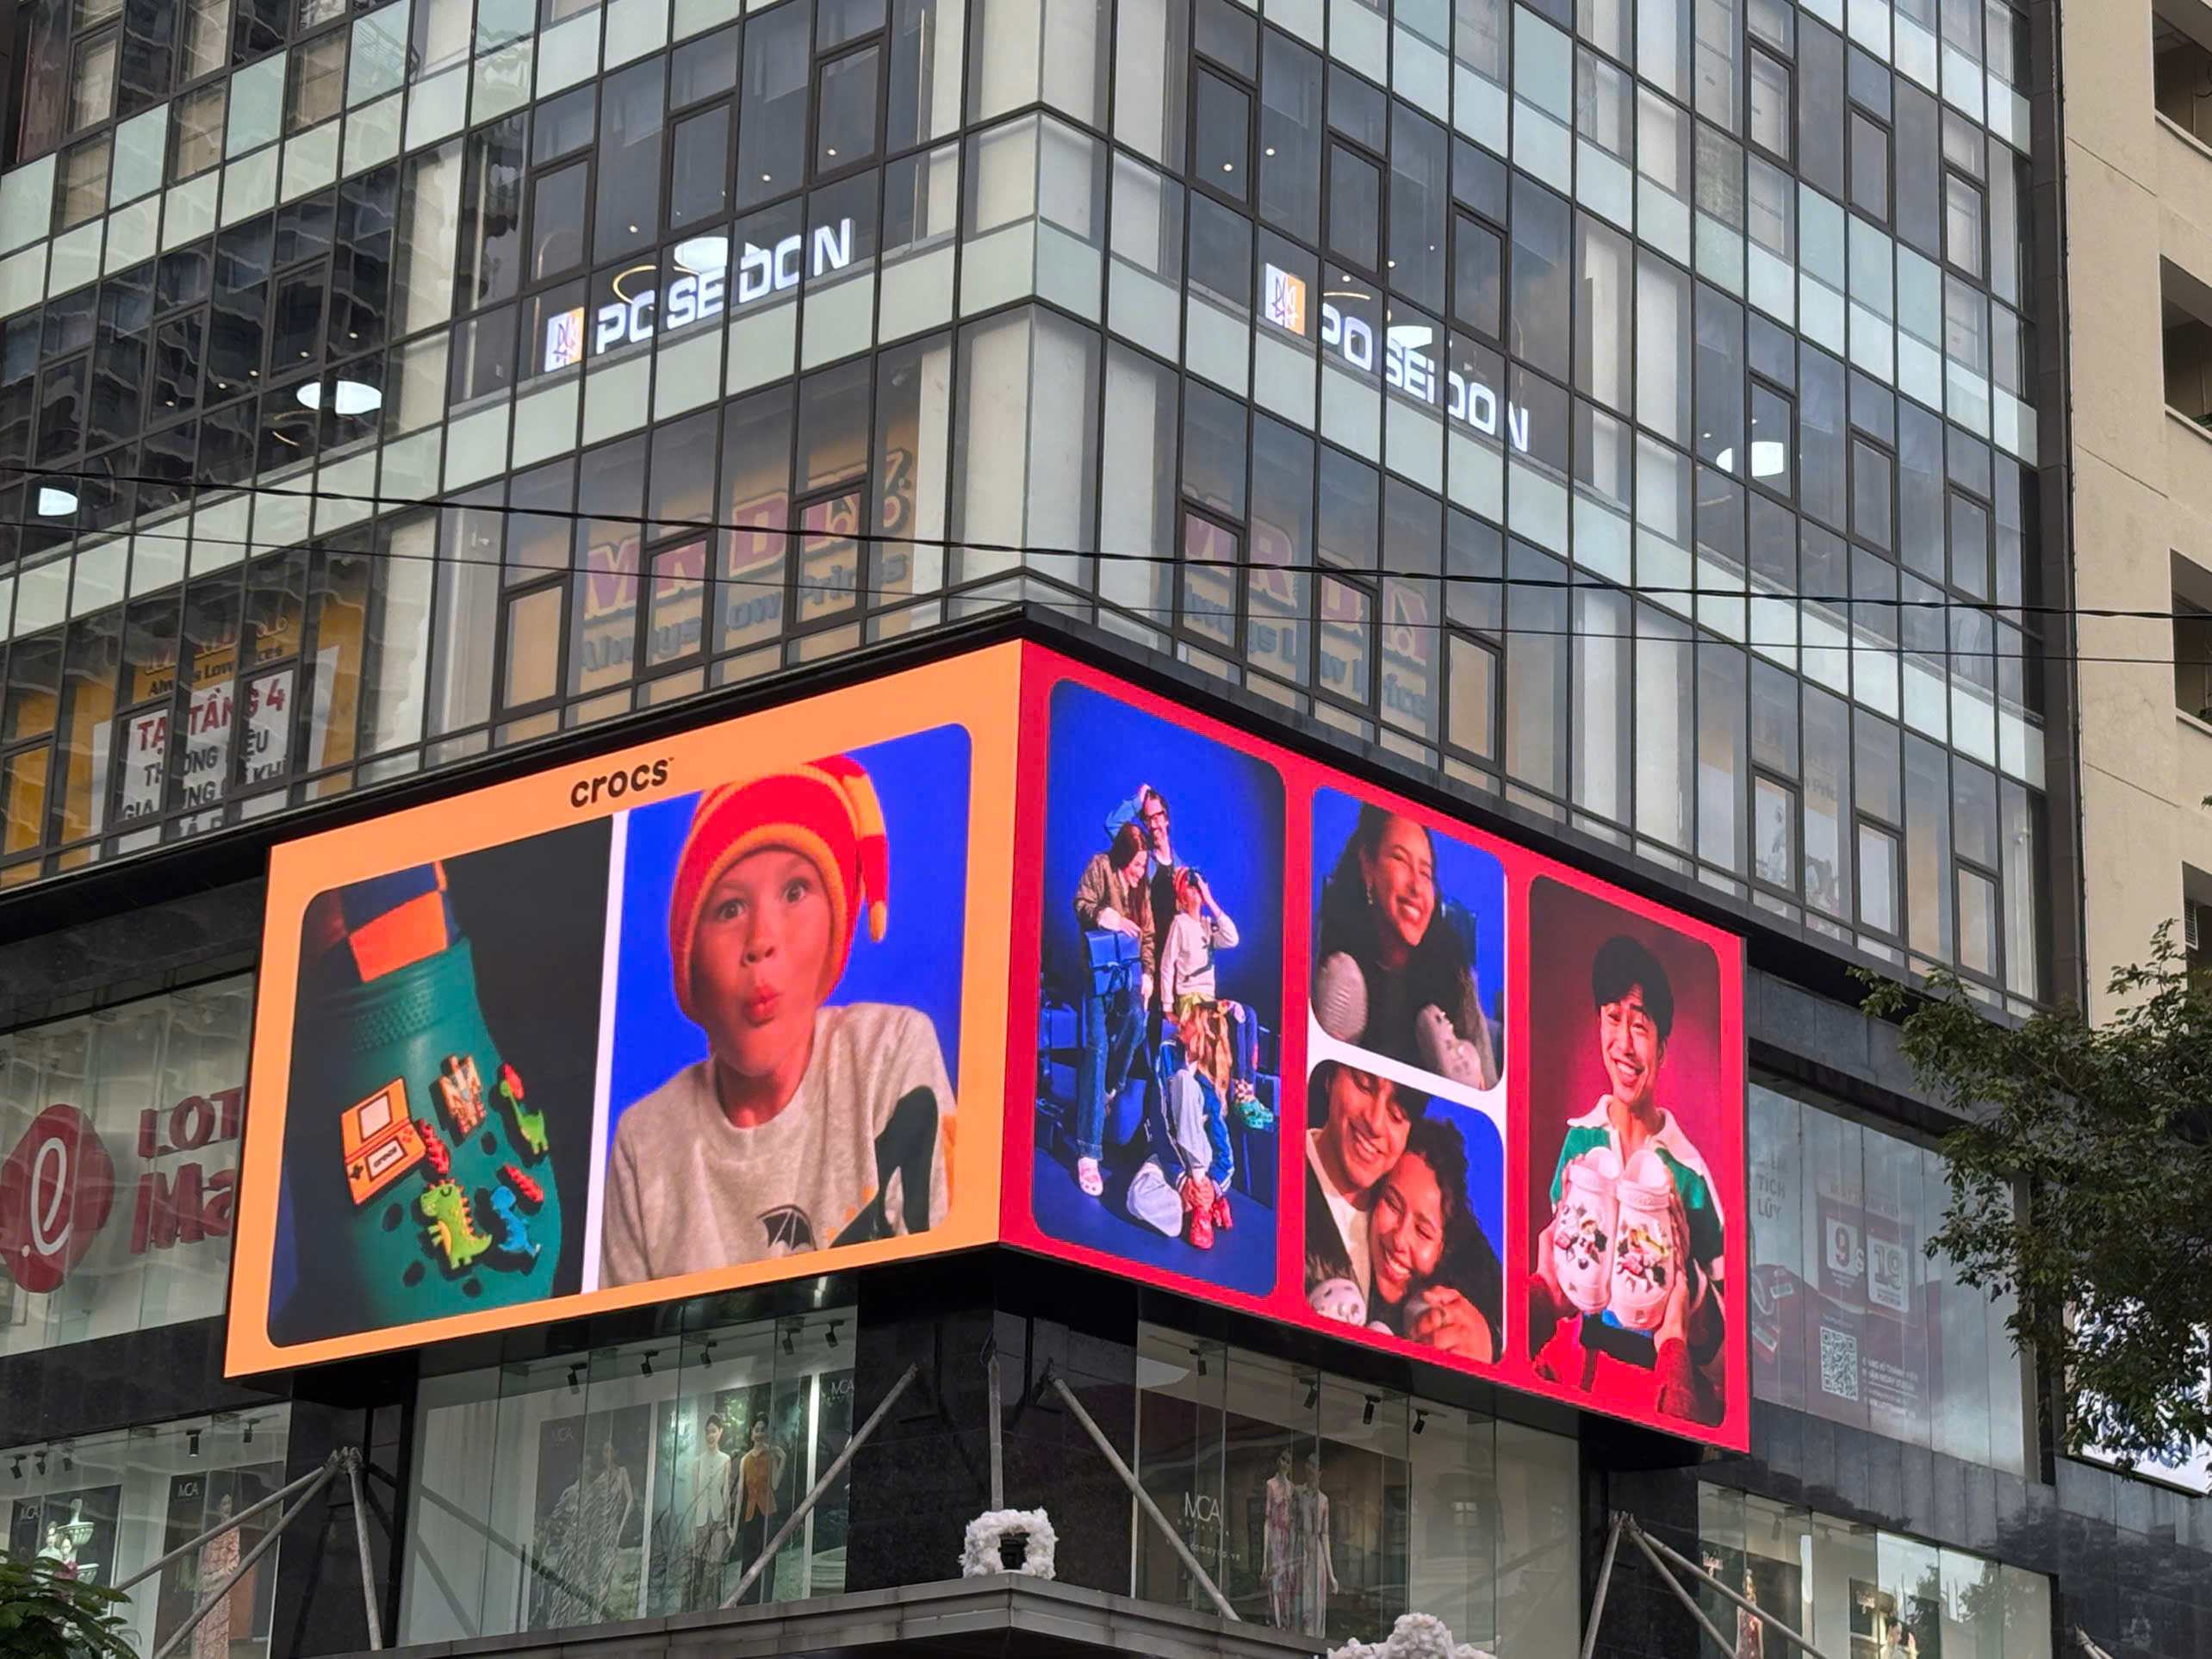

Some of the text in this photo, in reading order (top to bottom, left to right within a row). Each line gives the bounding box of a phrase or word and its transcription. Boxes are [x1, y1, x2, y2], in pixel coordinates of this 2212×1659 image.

[595, 218, 855, 355] POSEDON
[266, 678, 286, 711] 4
[570, 759, 669, 808] crocs
